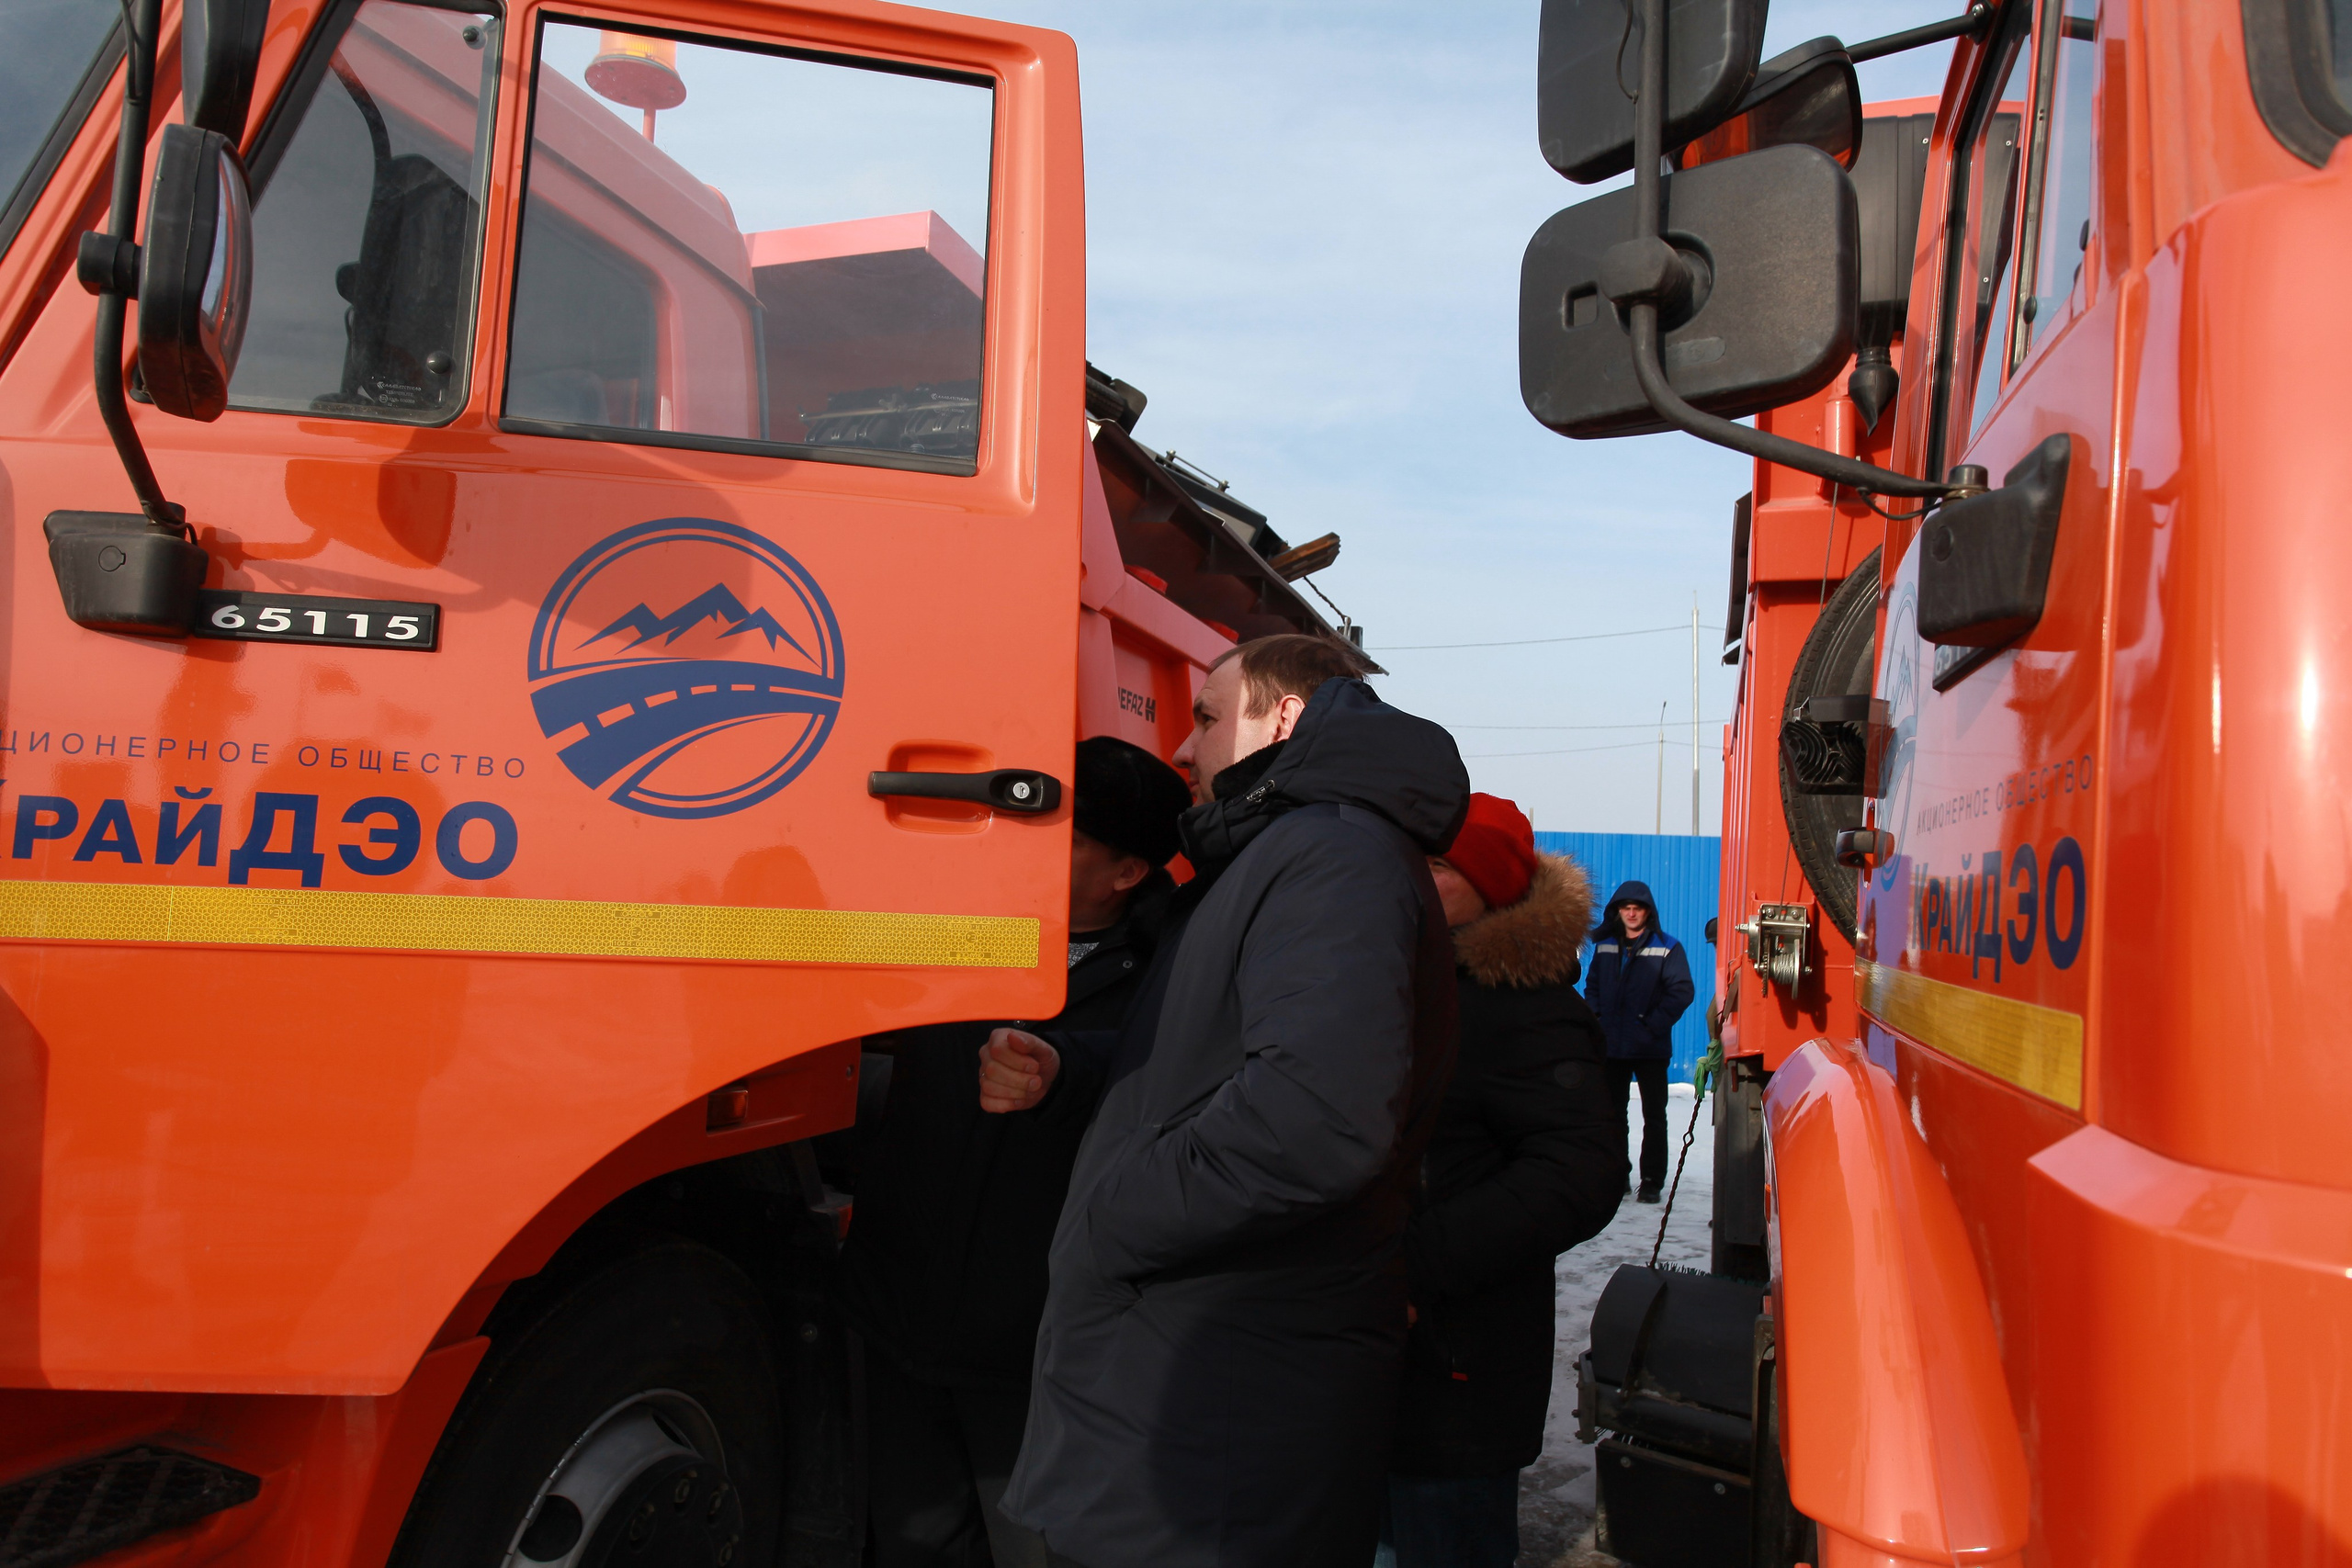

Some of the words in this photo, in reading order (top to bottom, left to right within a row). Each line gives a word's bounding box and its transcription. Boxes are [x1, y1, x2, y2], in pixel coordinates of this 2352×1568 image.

[211, 605, 420, 640] 65115
[298, 745, 526, 779] ОБЩЕСТВО
[1917, 787, 1989, 836] АКЦИОНЕРНОЕ
[1996, 755, 2093, 812] ОБЩЕСТВО
[0, 779, 518, 887] РАЙДЭО
[1911, 836, 2086, 984] КРАЙДЭО
